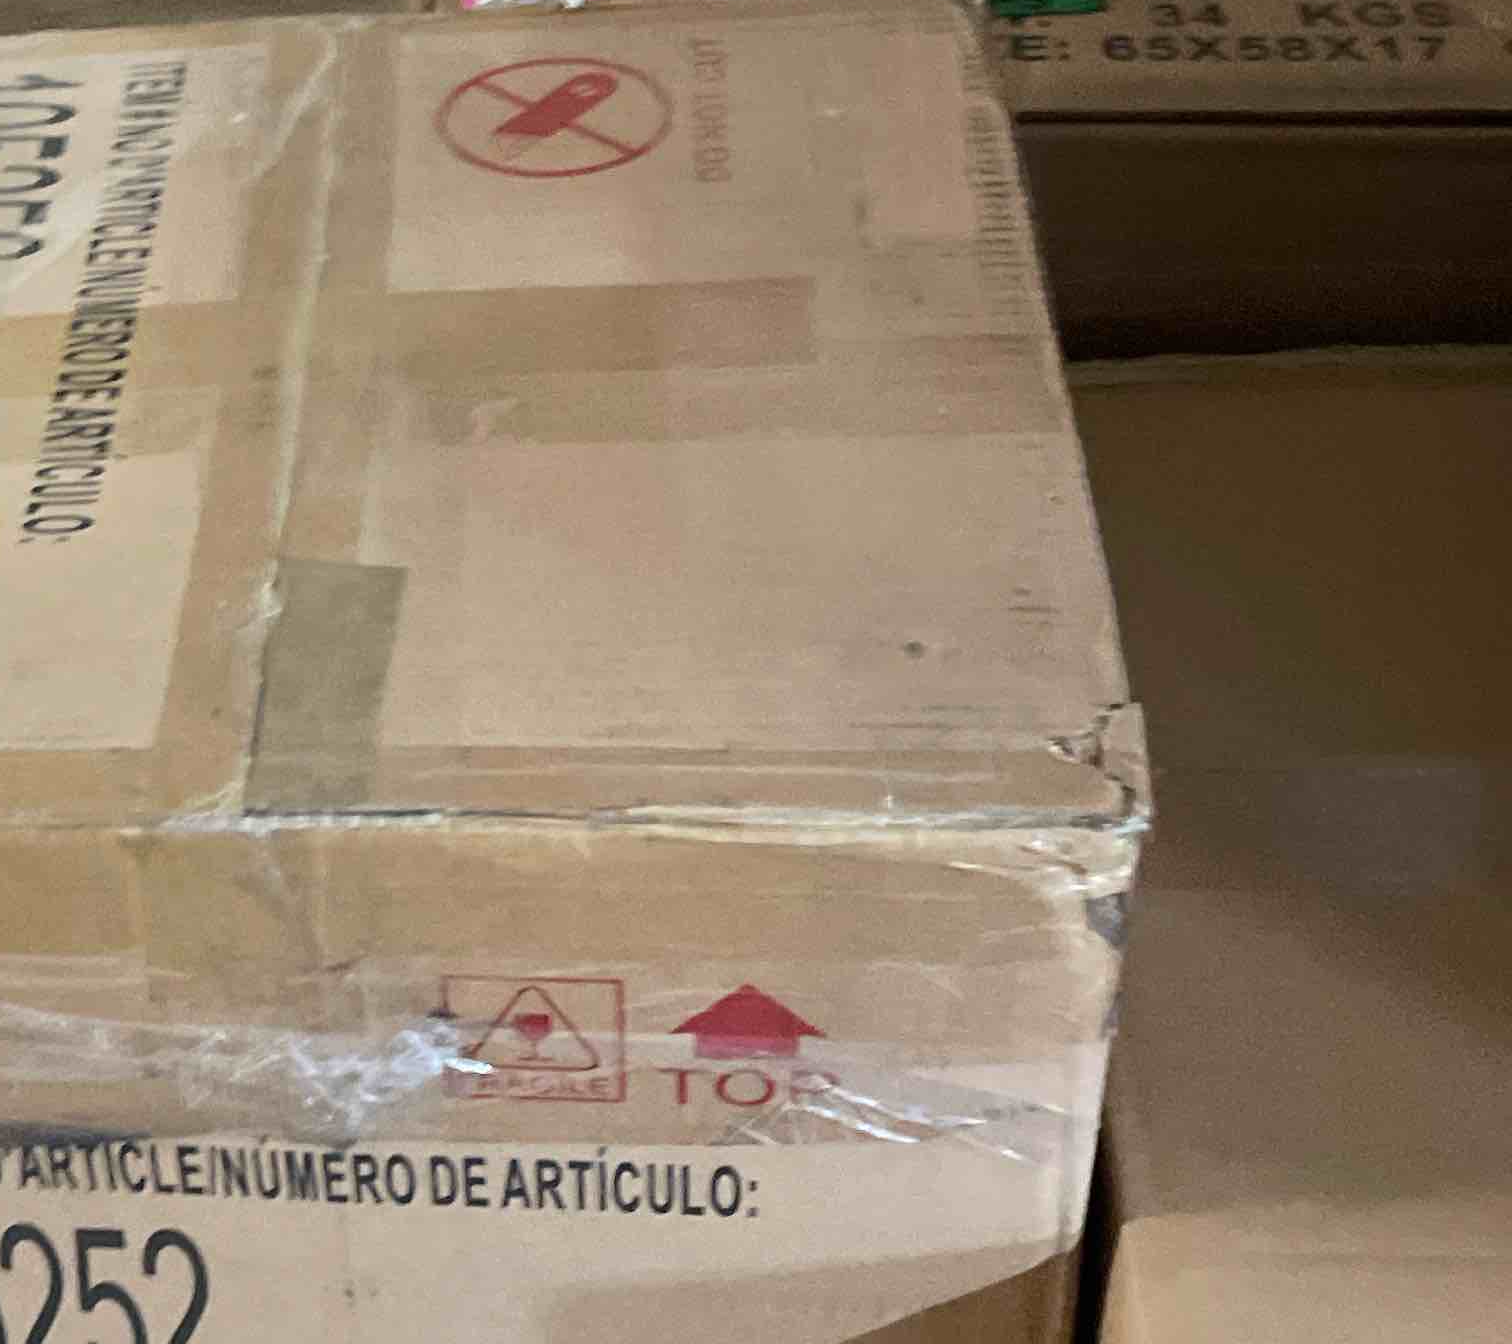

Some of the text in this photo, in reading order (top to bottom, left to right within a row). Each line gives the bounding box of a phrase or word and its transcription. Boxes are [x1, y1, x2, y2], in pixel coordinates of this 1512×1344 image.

[1149, 2, 1455, 28] 34 KGS
[51, 368, 128, 403] DE
[430, 1155, 491, 1208] DE
[502, 1146, 759, 1218] ARTÍCULO:
